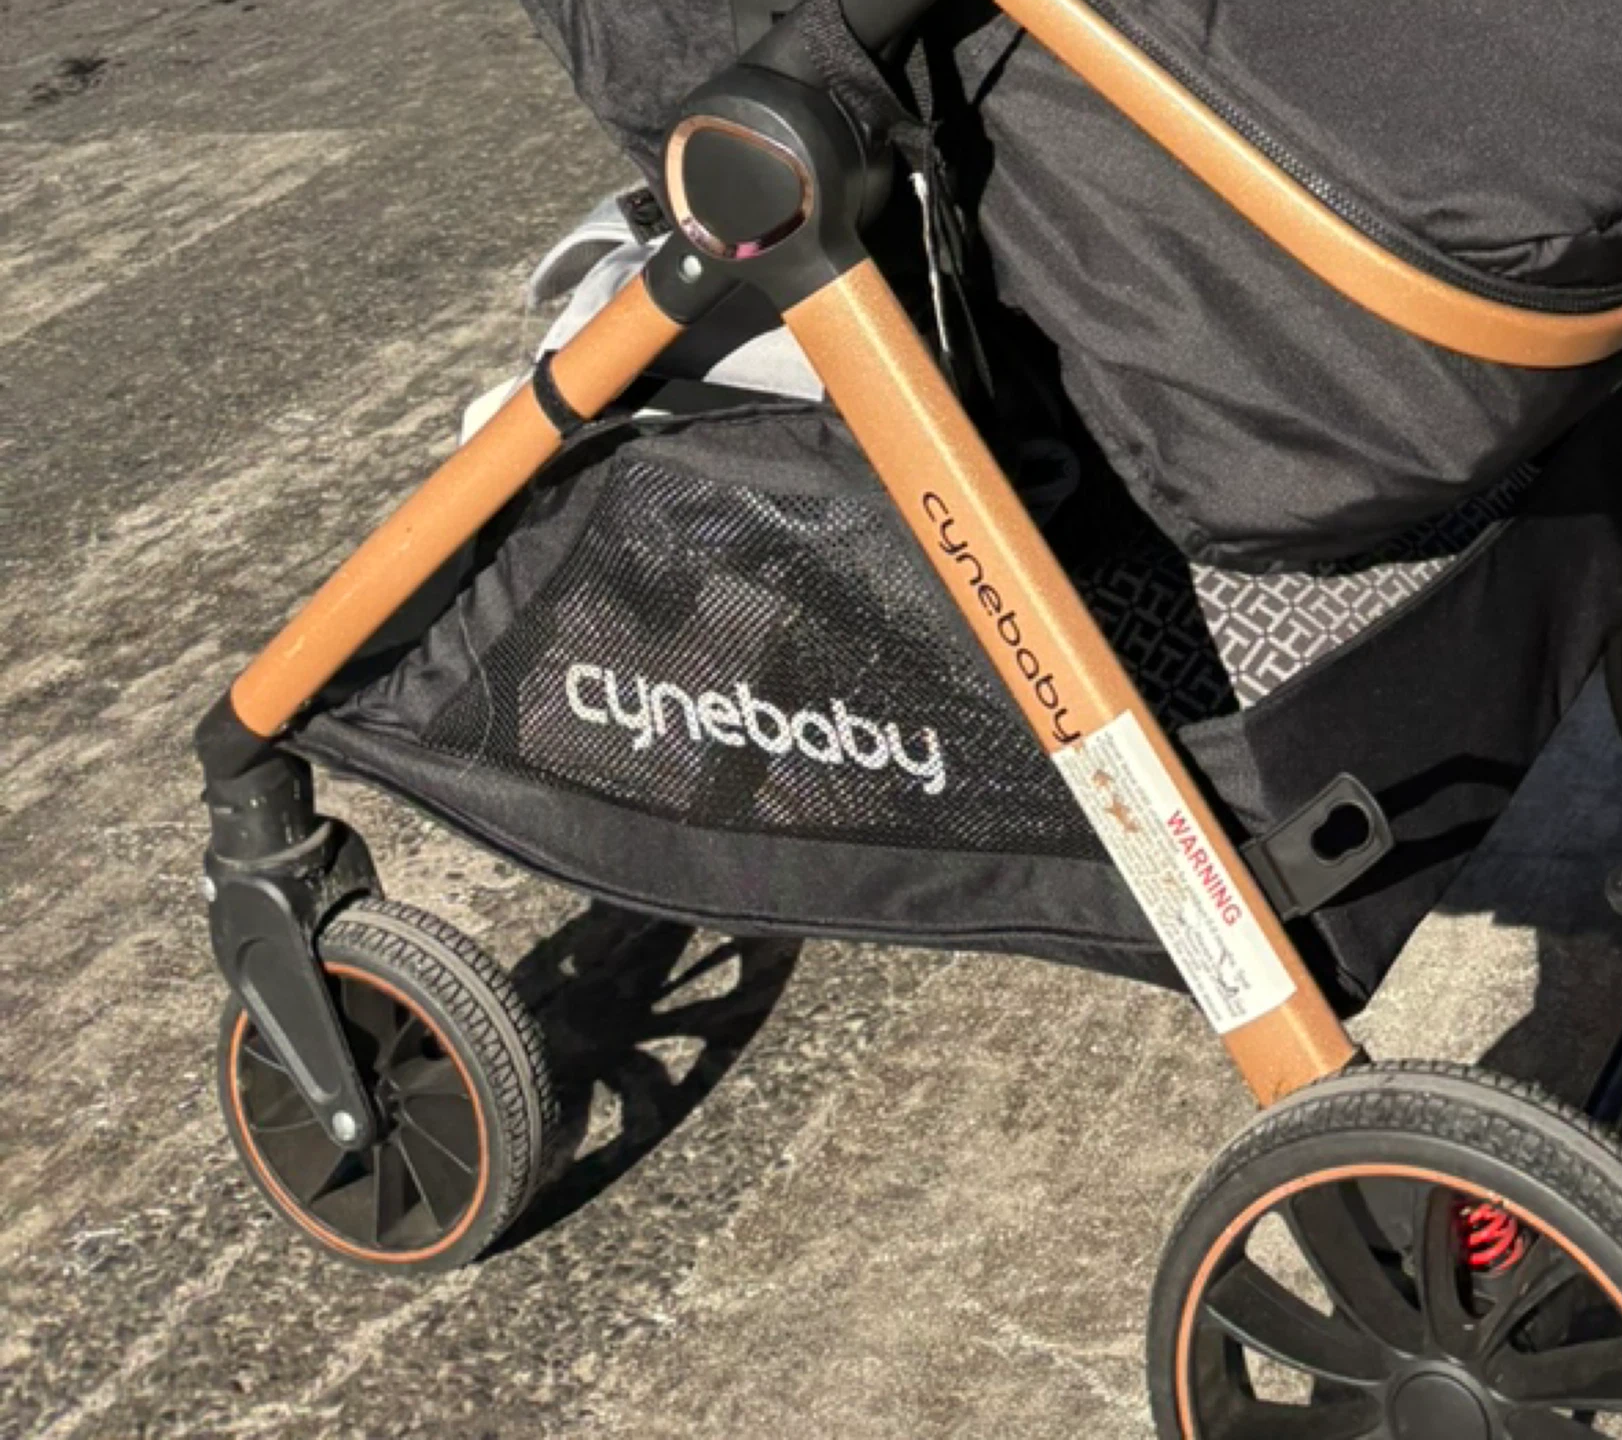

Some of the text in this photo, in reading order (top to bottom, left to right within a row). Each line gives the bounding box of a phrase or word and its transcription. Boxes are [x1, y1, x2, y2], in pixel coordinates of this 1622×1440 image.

[921, 491, 1081, 745] cynebaby
[565, 663, 947, 795] cynebaby
[1166, 809, 1243, 927] WARNING
